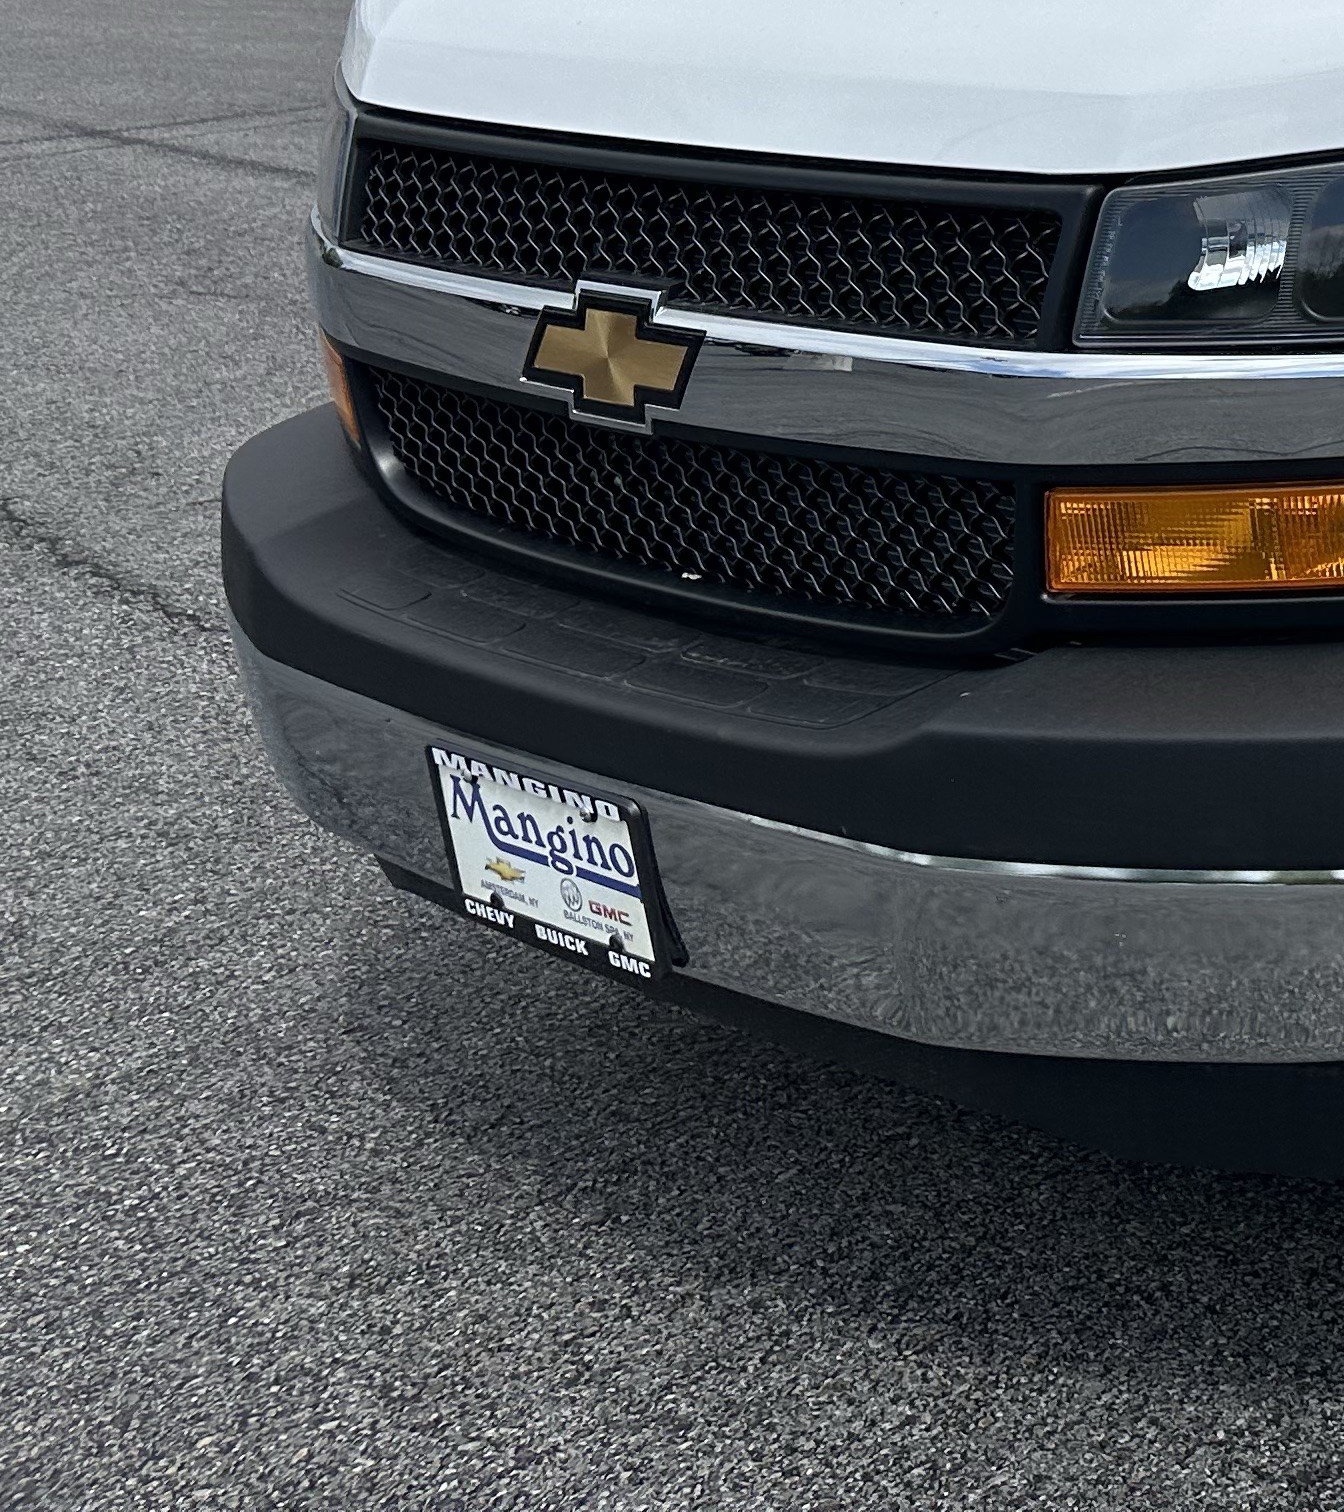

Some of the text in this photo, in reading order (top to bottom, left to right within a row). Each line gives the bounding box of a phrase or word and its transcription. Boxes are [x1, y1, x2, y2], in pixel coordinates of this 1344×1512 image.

[431, 746, 621, 821] MANGINO
[450, 775, 635, 877] Mangino
[464, 898, 652, 978] CHEVY BUICK GMC
[563, 909, 604, 931] BALLSTON
[588, 900, 633, 926] GMC
